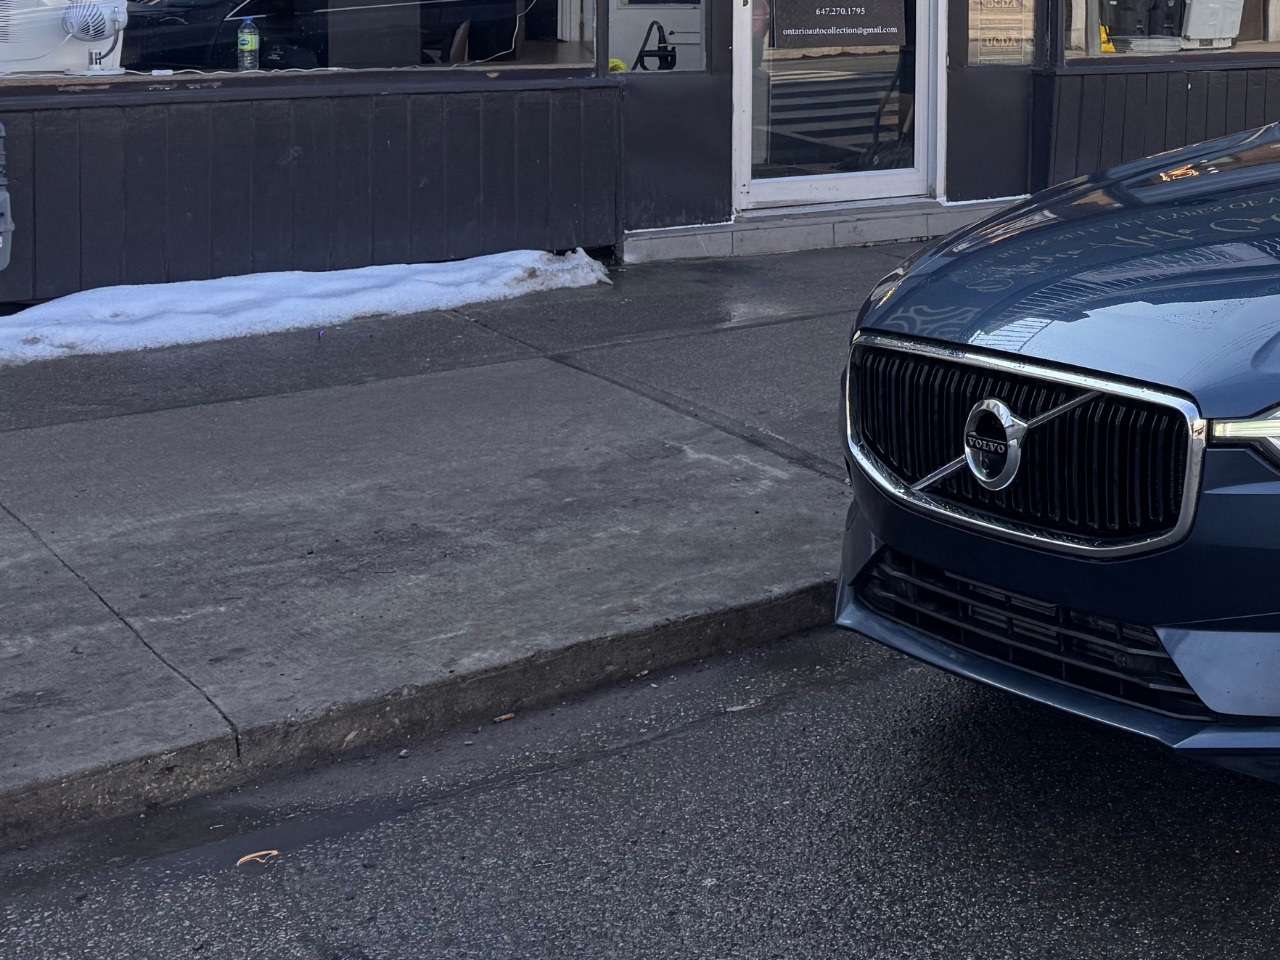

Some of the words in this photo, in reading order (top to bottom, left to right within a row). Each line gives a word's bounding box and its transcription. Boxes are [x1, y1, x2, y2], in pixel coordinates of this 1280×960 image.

[815, 7, 866, 15] 647.270.1795
[782, 25, 898, 36] ontarioautocollection@gmail.com
[967, 437, 1005, 453] VOLVO
